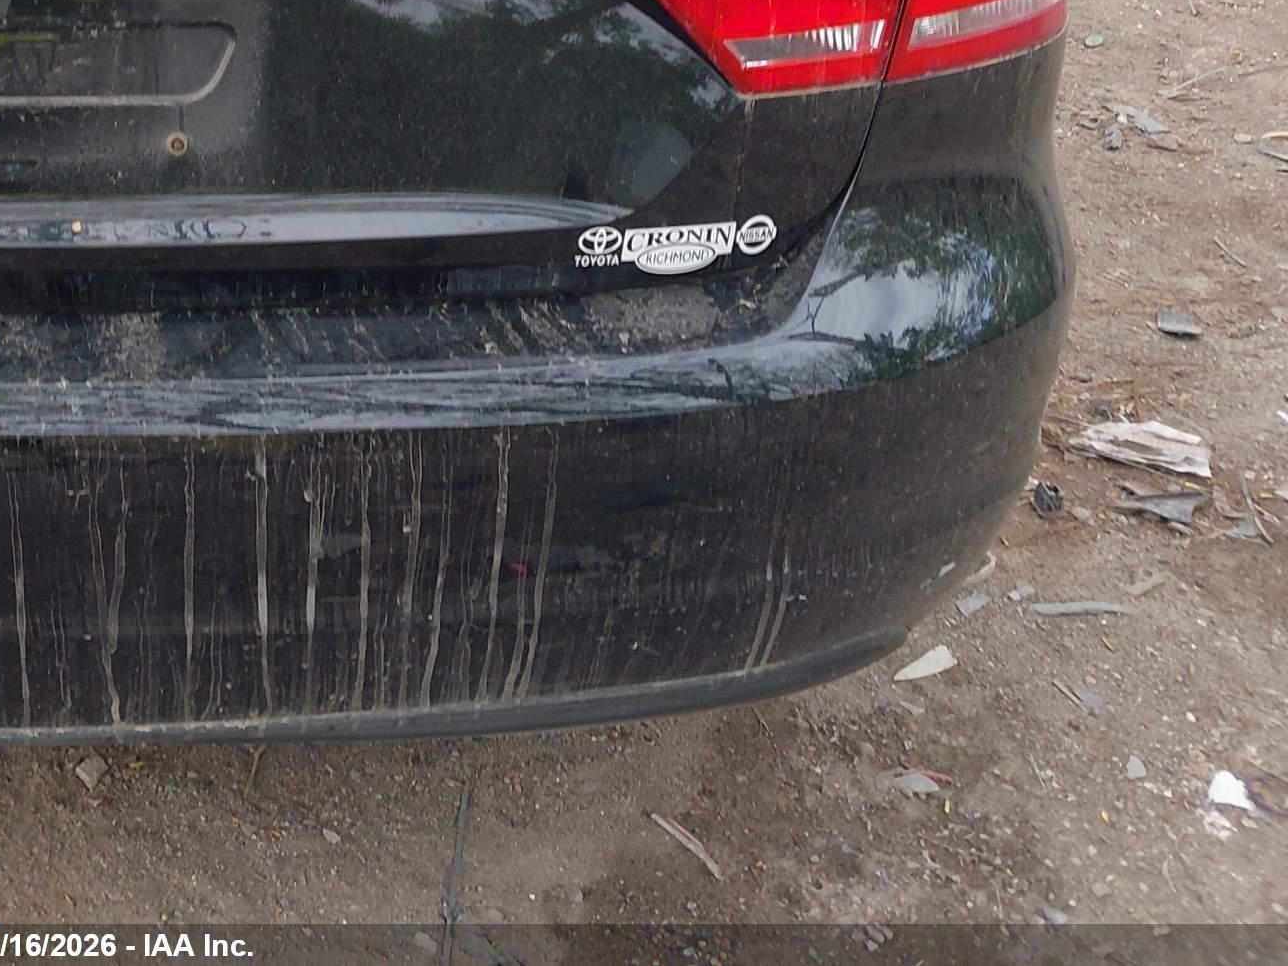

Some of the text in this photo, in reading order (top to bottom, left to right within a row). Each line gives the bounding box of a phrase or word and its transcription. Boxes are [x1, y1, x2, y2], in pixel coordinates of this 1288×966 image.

[626, 223, 734, 253] CRONIN
[574, 254, 619, 268] TOYOTA
[645, 248, 710, 265] RICHMOND
